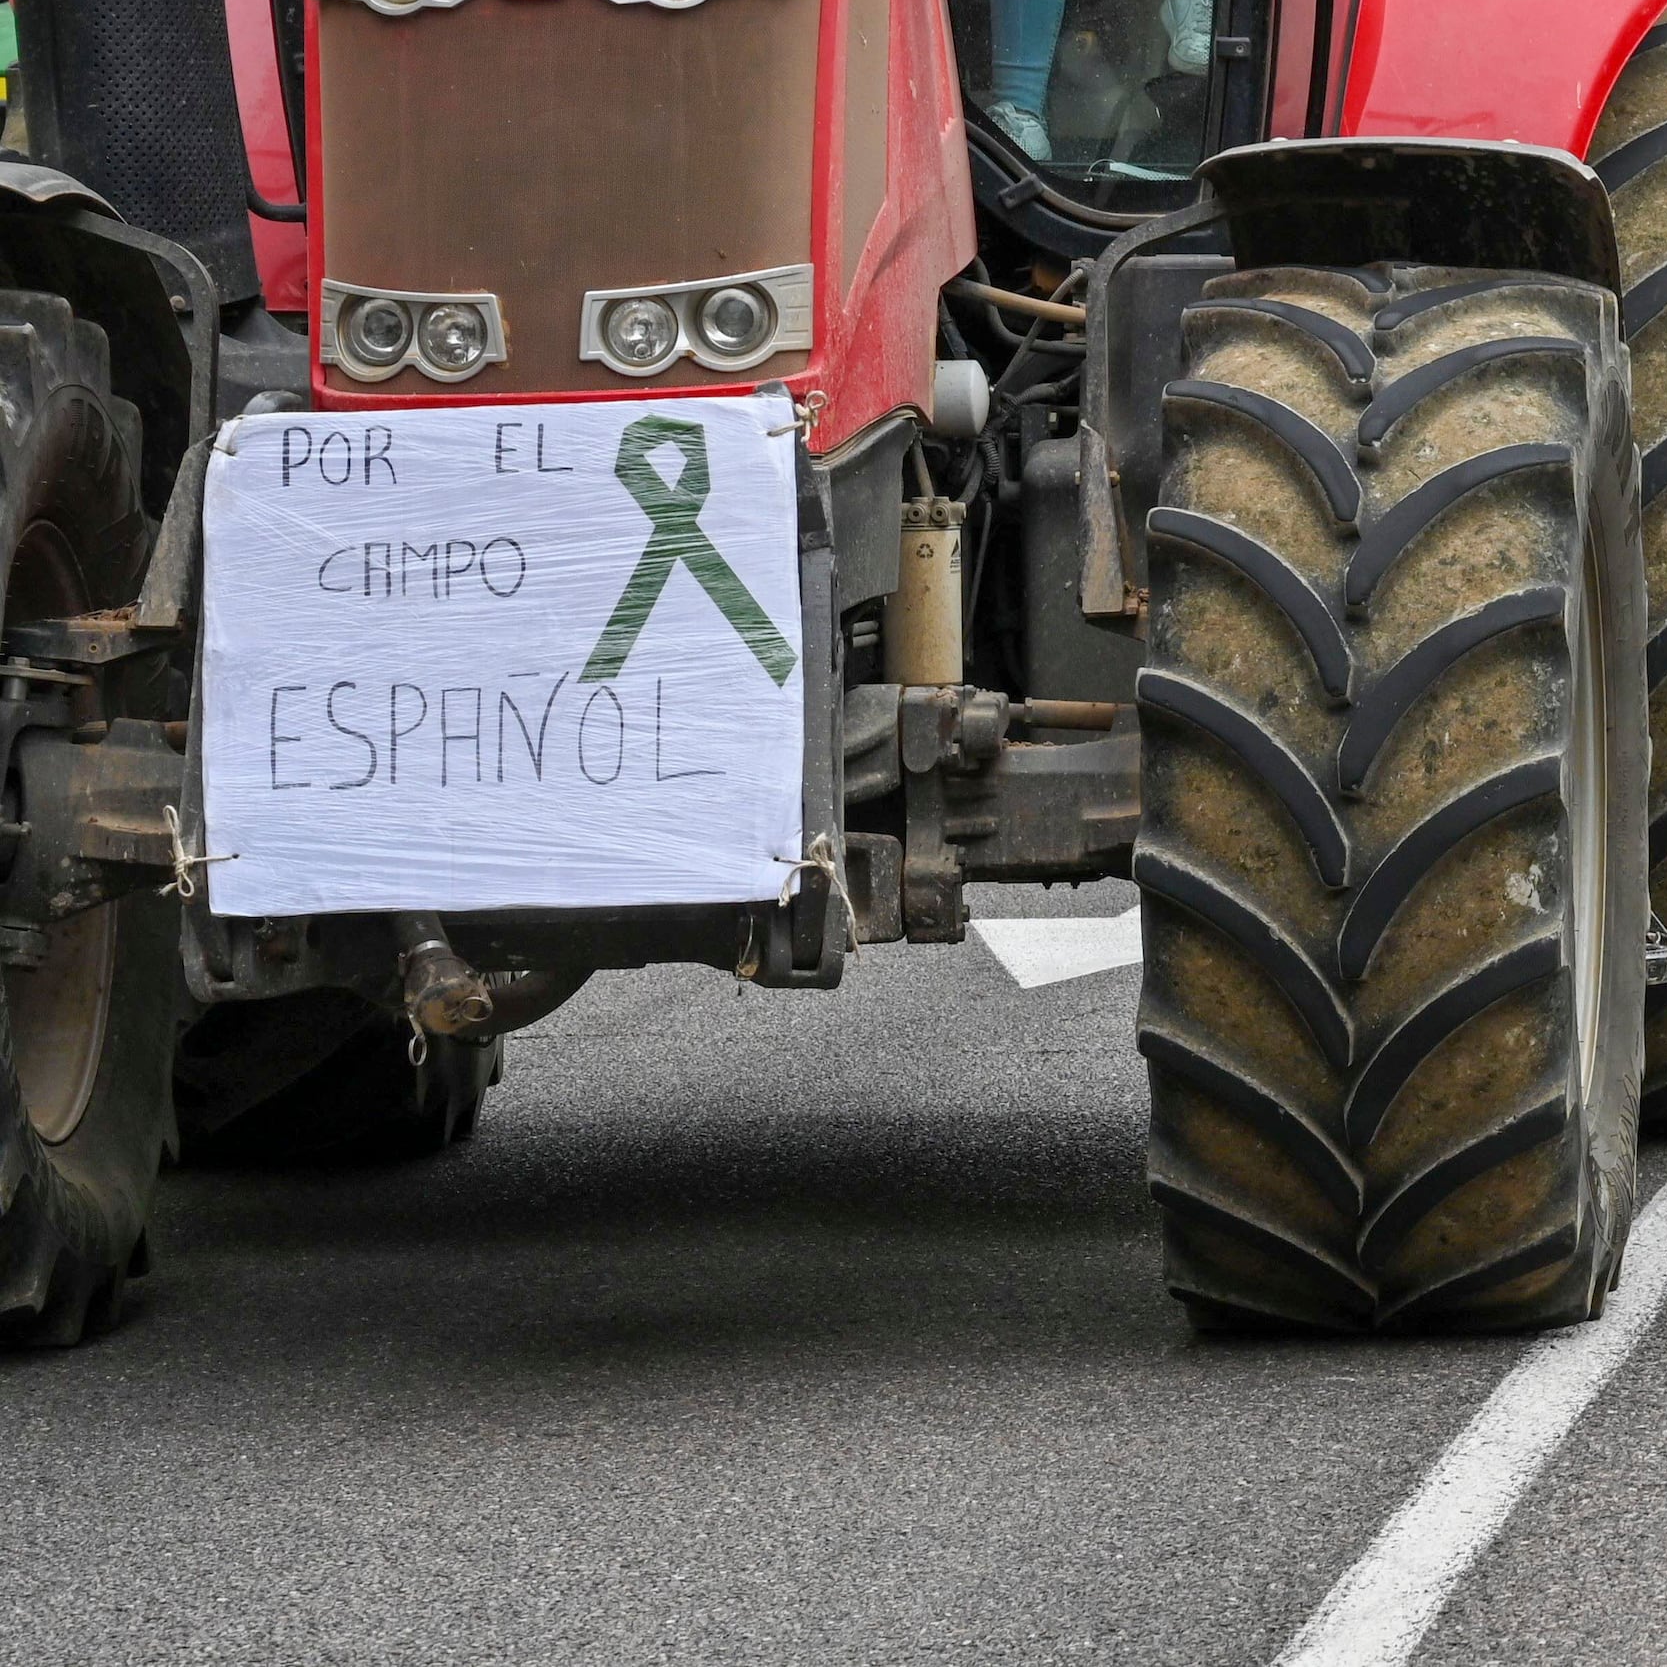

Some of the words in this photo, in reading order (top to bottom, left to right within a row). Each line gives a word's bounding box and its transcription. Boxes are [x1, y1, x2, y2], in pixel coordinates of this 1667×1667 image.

[280, 424, 398, 488] POR
[494, 421, 575, 474] EL
[317, 535, 527, 600] CAMPO
[269, 670, 726, 791] ESPAÑOL
